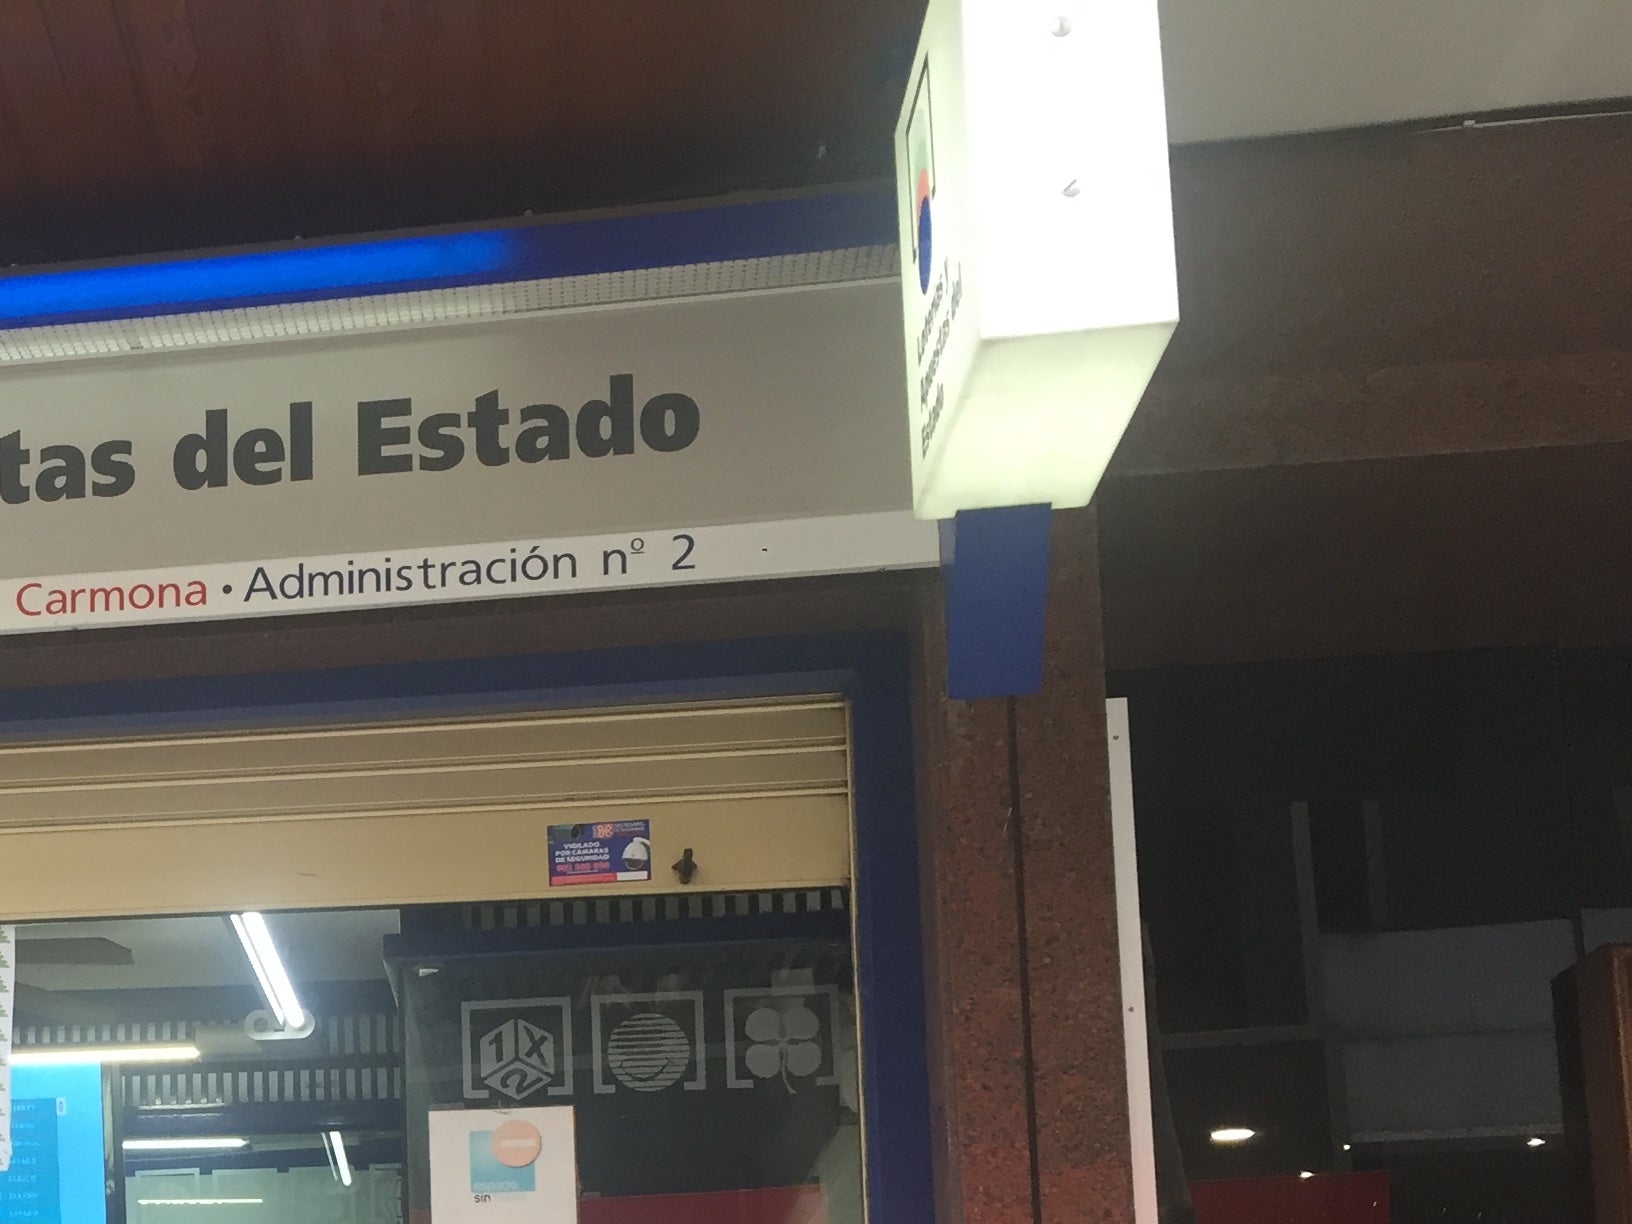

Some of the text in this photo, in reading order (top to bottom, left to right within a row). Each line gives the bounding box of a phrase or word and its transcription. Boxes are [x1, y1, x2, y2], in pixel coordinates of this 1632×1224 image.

[173, 403, 313, 490] del
[357, 374, 700, 476] Estado
[16, 576, 208, 617] Carmona
[243, 544, 577, 603] Administración
[671, 534, 696, 572] 2
[473, 1194, 492, 1203] sin
